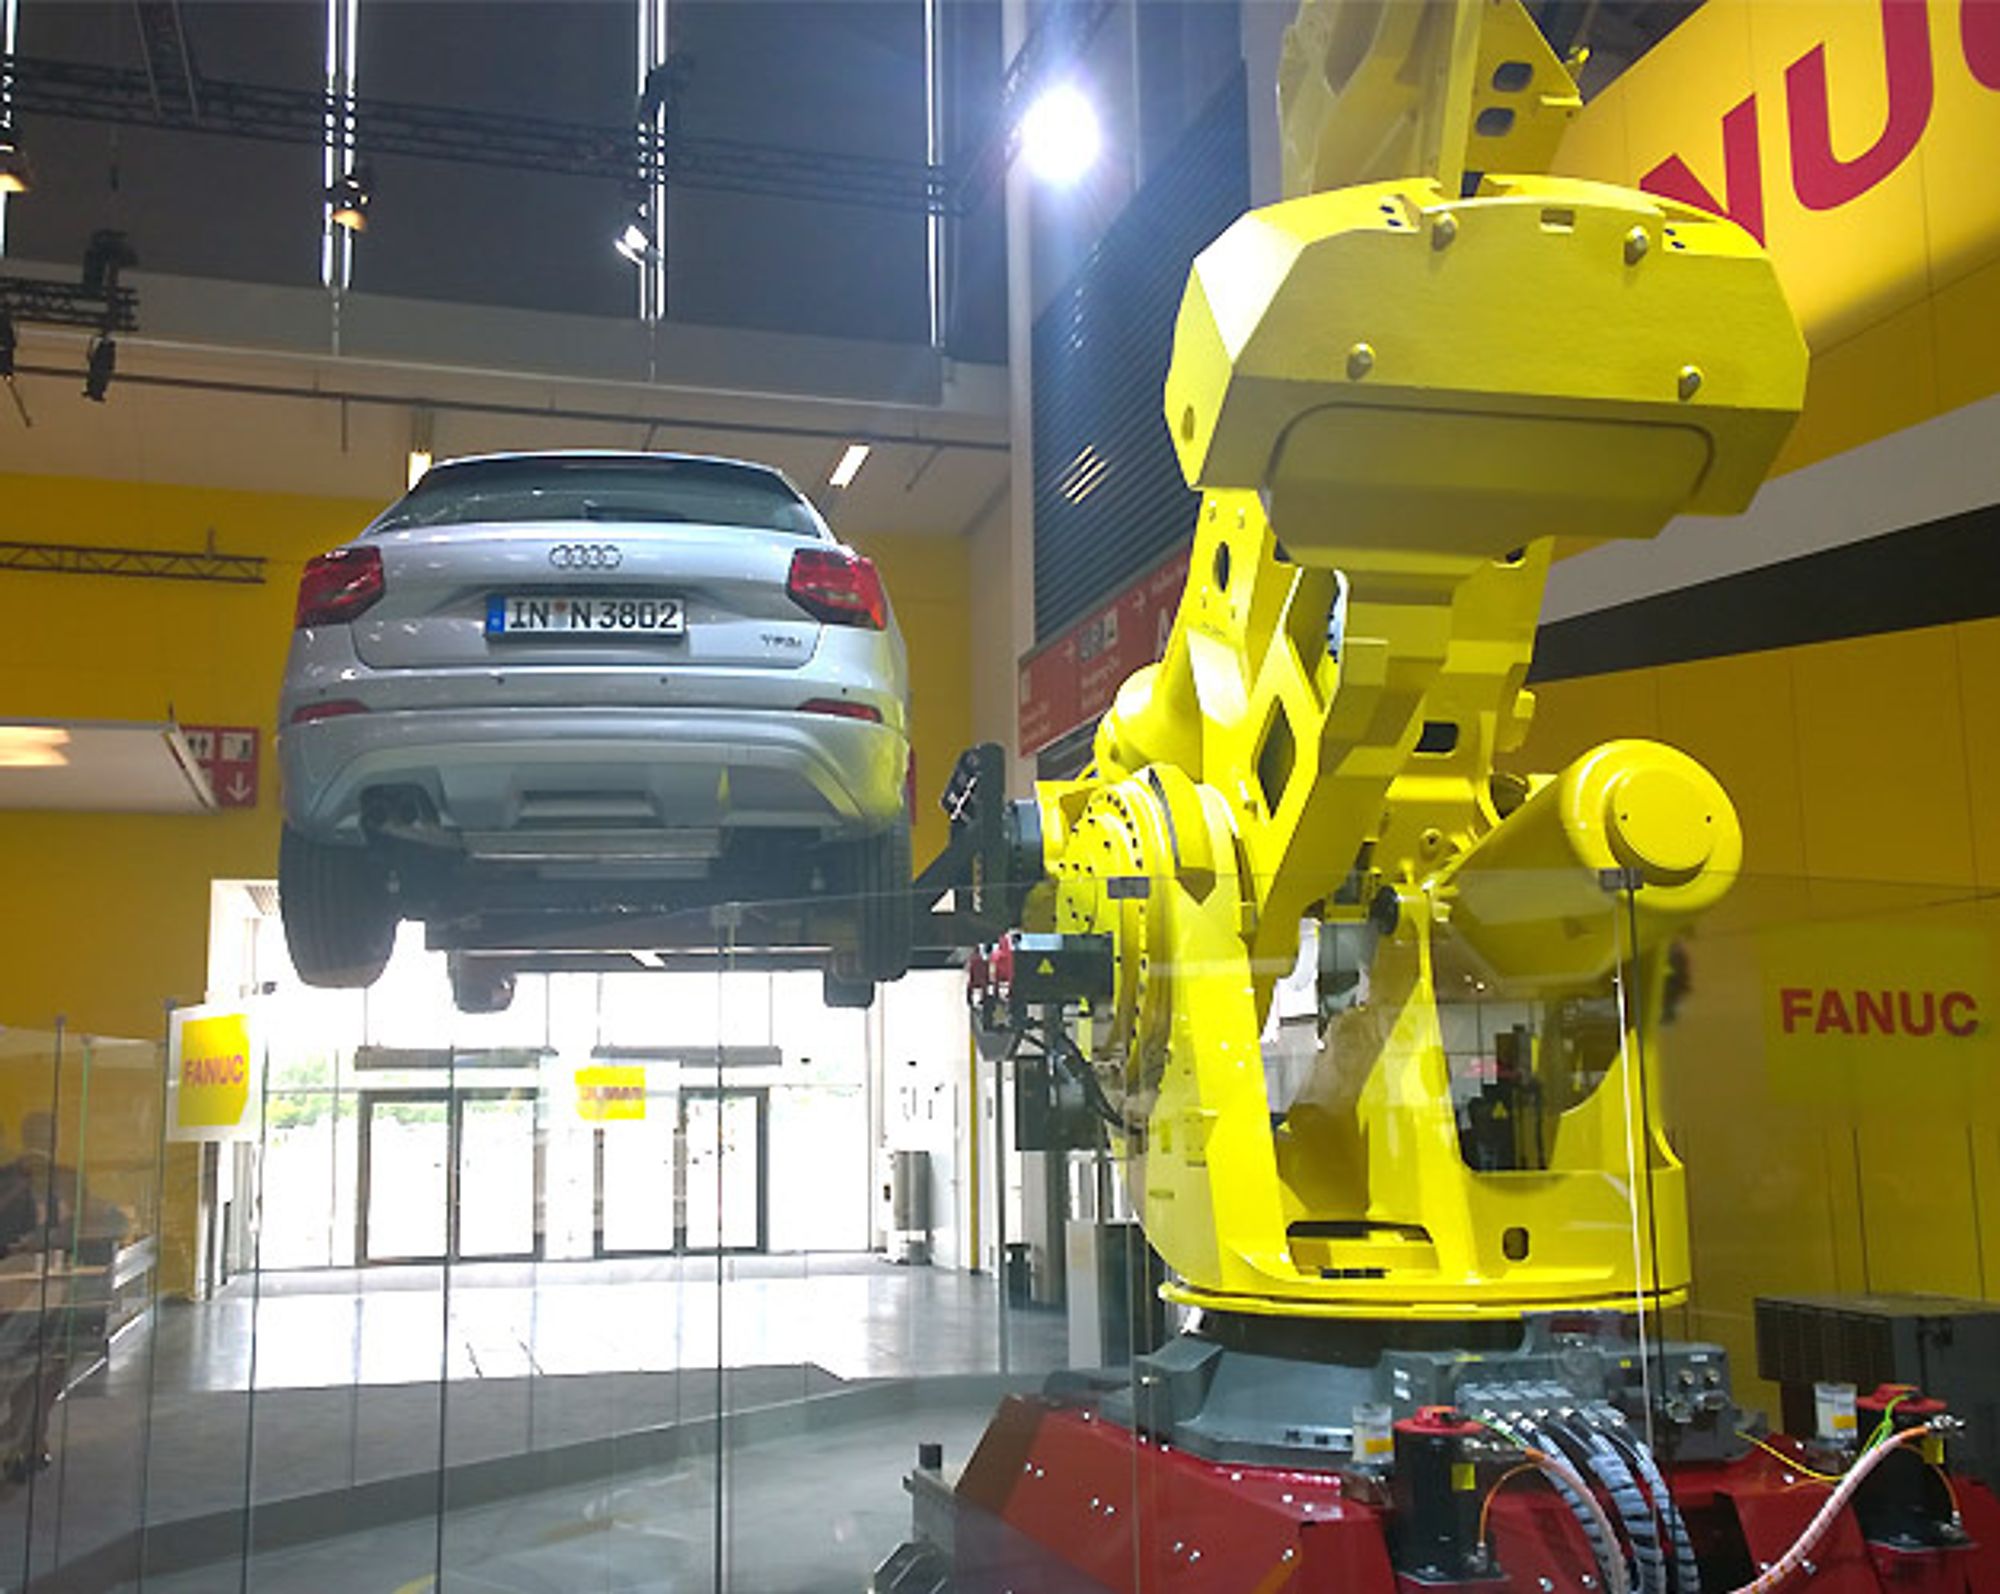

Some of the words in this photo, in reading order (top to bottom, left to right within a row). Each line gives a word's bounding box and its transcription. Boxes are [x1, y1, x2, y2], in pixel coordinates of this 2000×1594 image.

[510, 602, 548, 629] IN
[570, 602, 592, 629] N
[598, 602, 678, 629] 3802
[1780, 987, 1980, 1037] FANUC
[184, 1054, 244, 1086] FANUC
